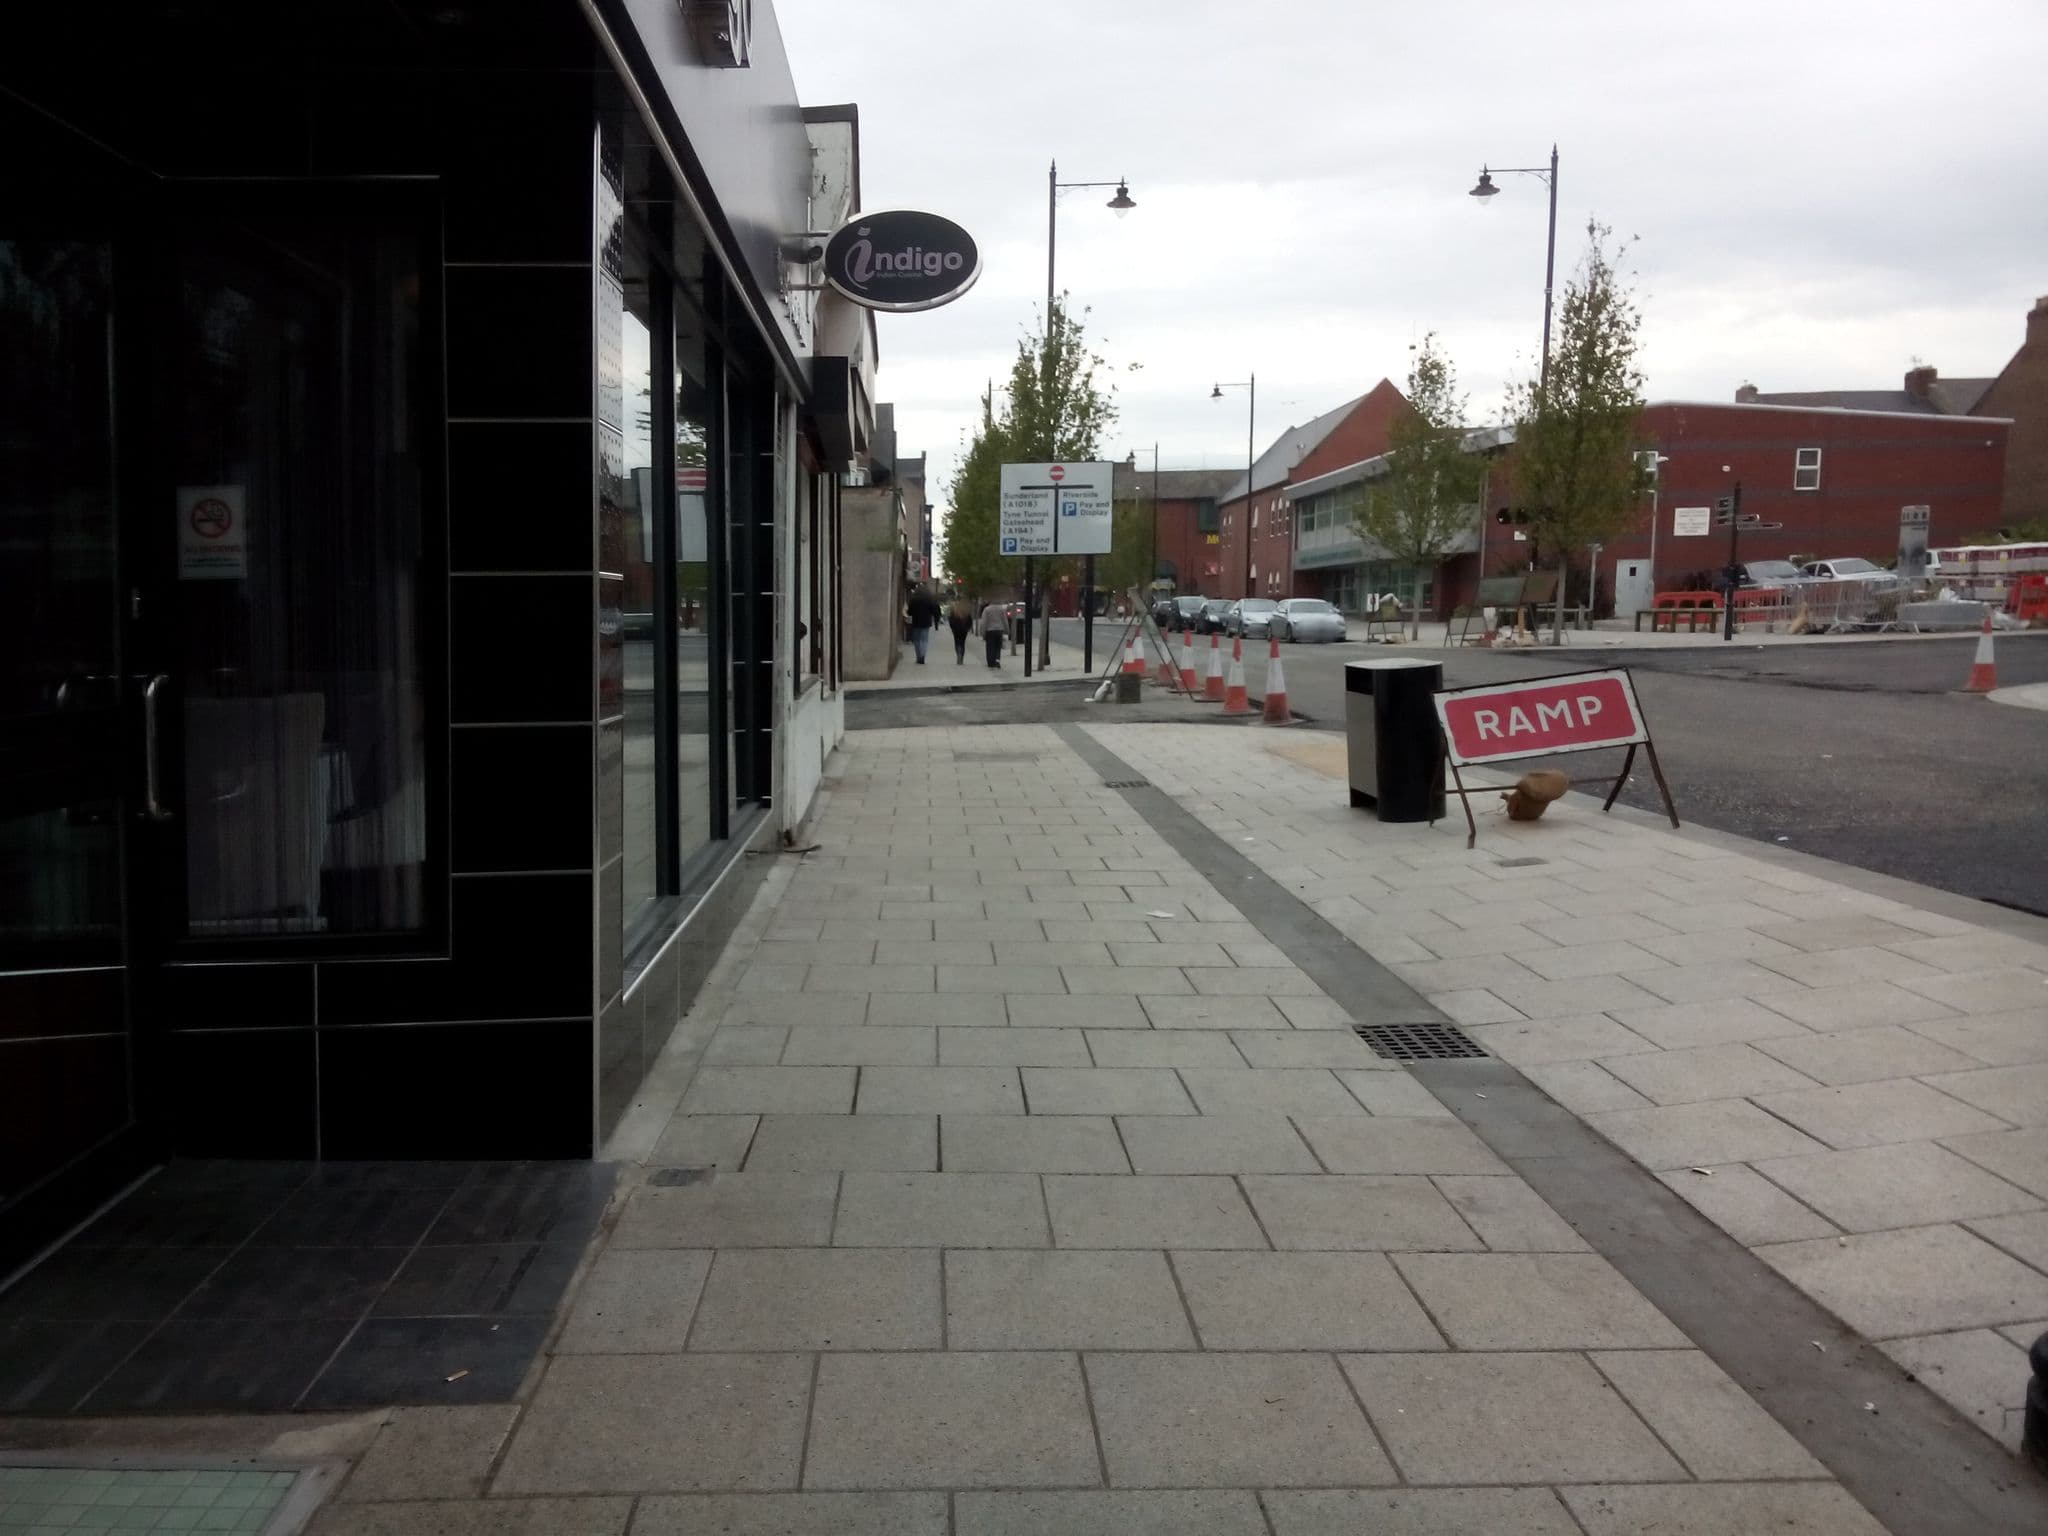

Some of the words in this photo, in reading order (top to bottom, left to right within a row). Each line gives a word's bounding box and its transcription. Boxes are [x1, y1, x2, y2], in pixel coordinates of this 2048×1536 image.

[1003, 492, 1049, 500] Sunderland
[1003, 511, 1021, 519] Tyne
[1024, 510, 1049, 518] Tunnel
[1080, 509, 1108, 517] Display
[1003, 519, 1044, 527] Gateshead
[1020, 537, 1033, 545] Pay
[1021, 545, 1049, 553] Display
[1474, 695, 1603, 740] RAMP
